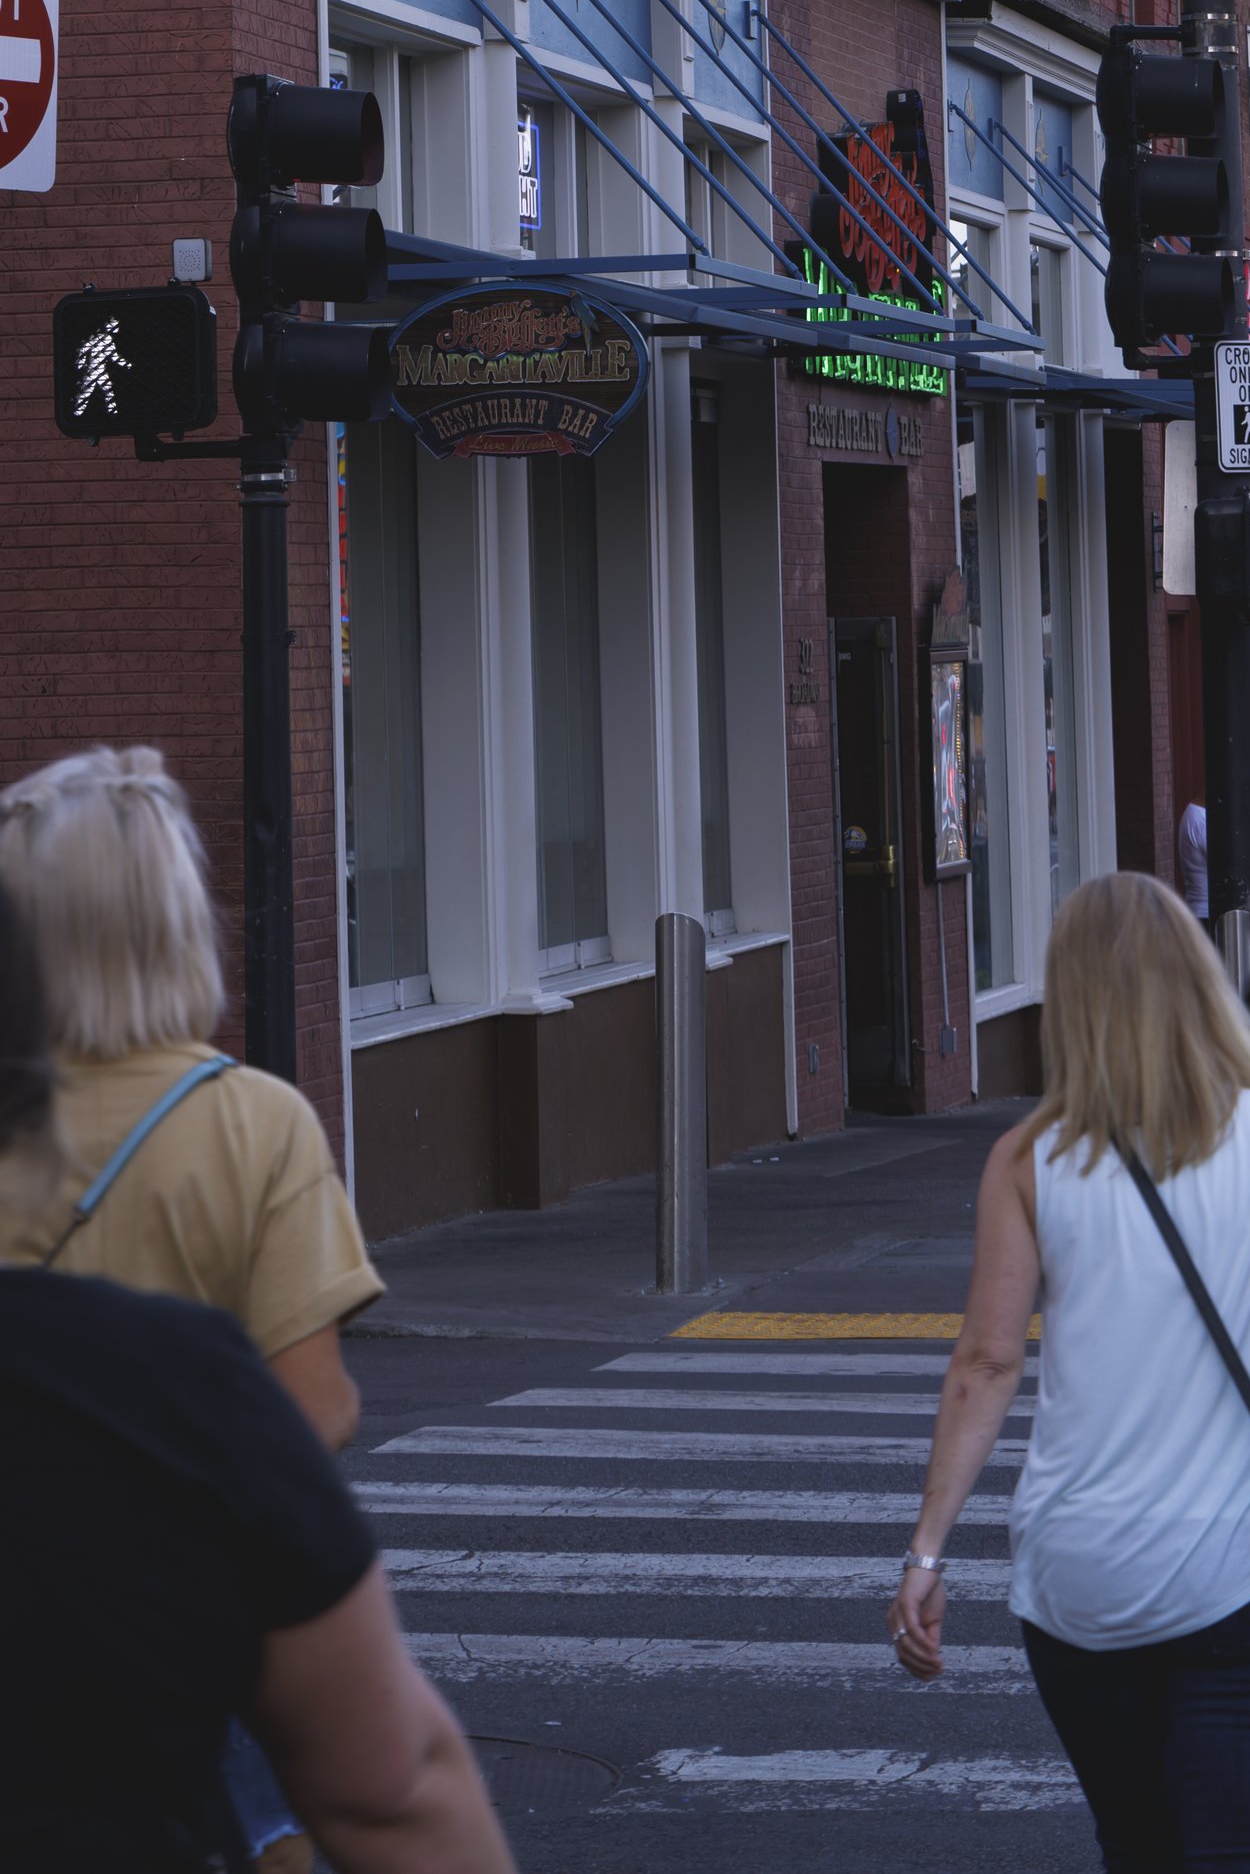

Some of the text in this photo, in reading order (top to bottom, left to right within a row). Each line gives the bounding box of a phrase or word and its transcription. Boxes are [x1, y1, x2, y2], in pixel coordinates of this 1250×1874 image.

[436, 299, 532, 350] Jimmy
[396, 339, 631, 386] MARGARITAVILLE
[430, 397, 598, 441] RESTAURANT BAR
[808, 402, 925, 458] RESTAURANT BAR
[468, 434, 561, 452] Live Music
